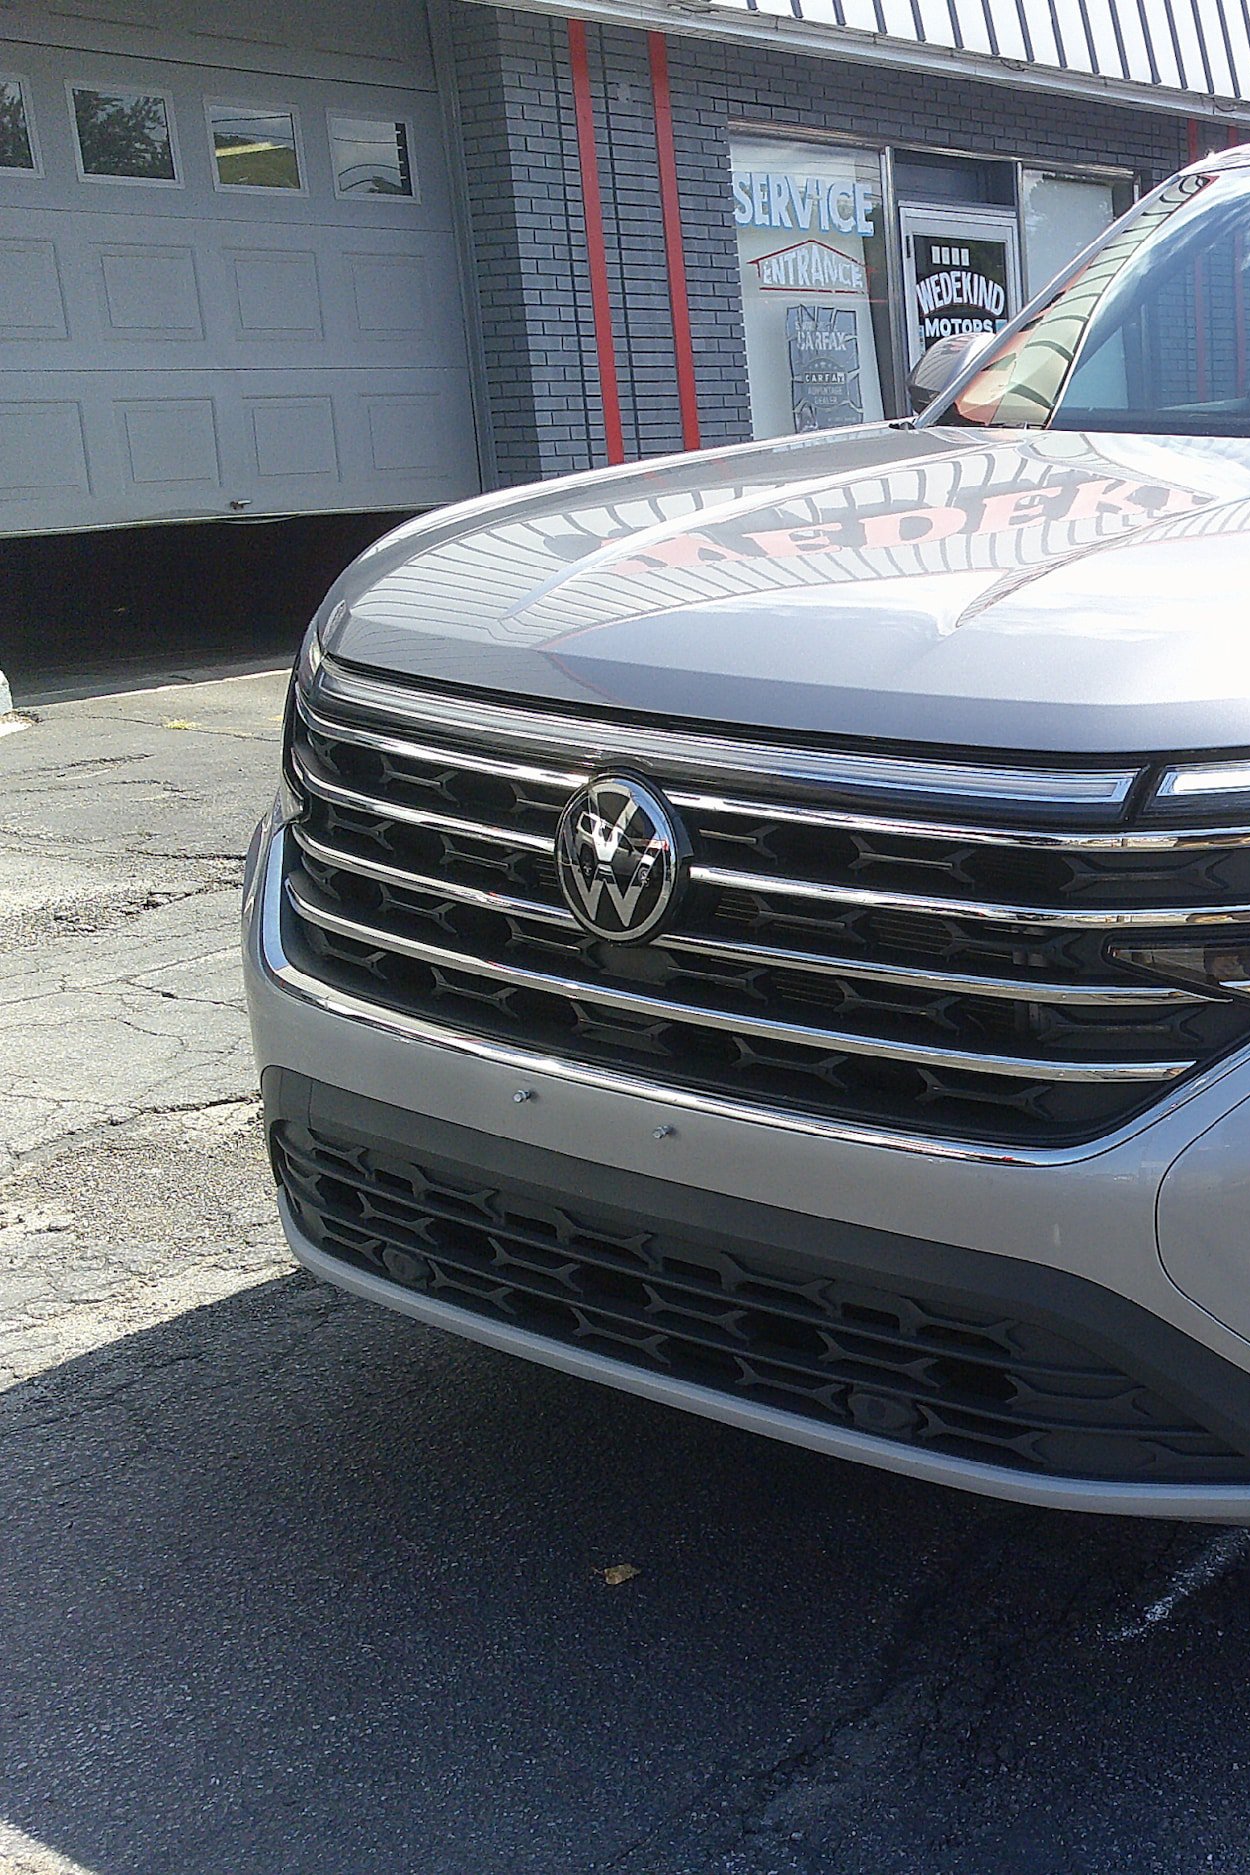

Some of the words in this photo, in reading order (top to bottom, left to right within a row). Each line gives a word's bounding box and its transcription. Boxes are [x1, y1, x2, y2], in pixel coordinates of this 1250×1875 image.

[731, 172, 875, 237] SERVICE
[761, 246, 864, 289] ENTRANCE
[916, 270, 1005, 316] WEDEKIND
[796, 331, 848, 351] CARFAX
[924, 317, 994, 338] MOTORS
